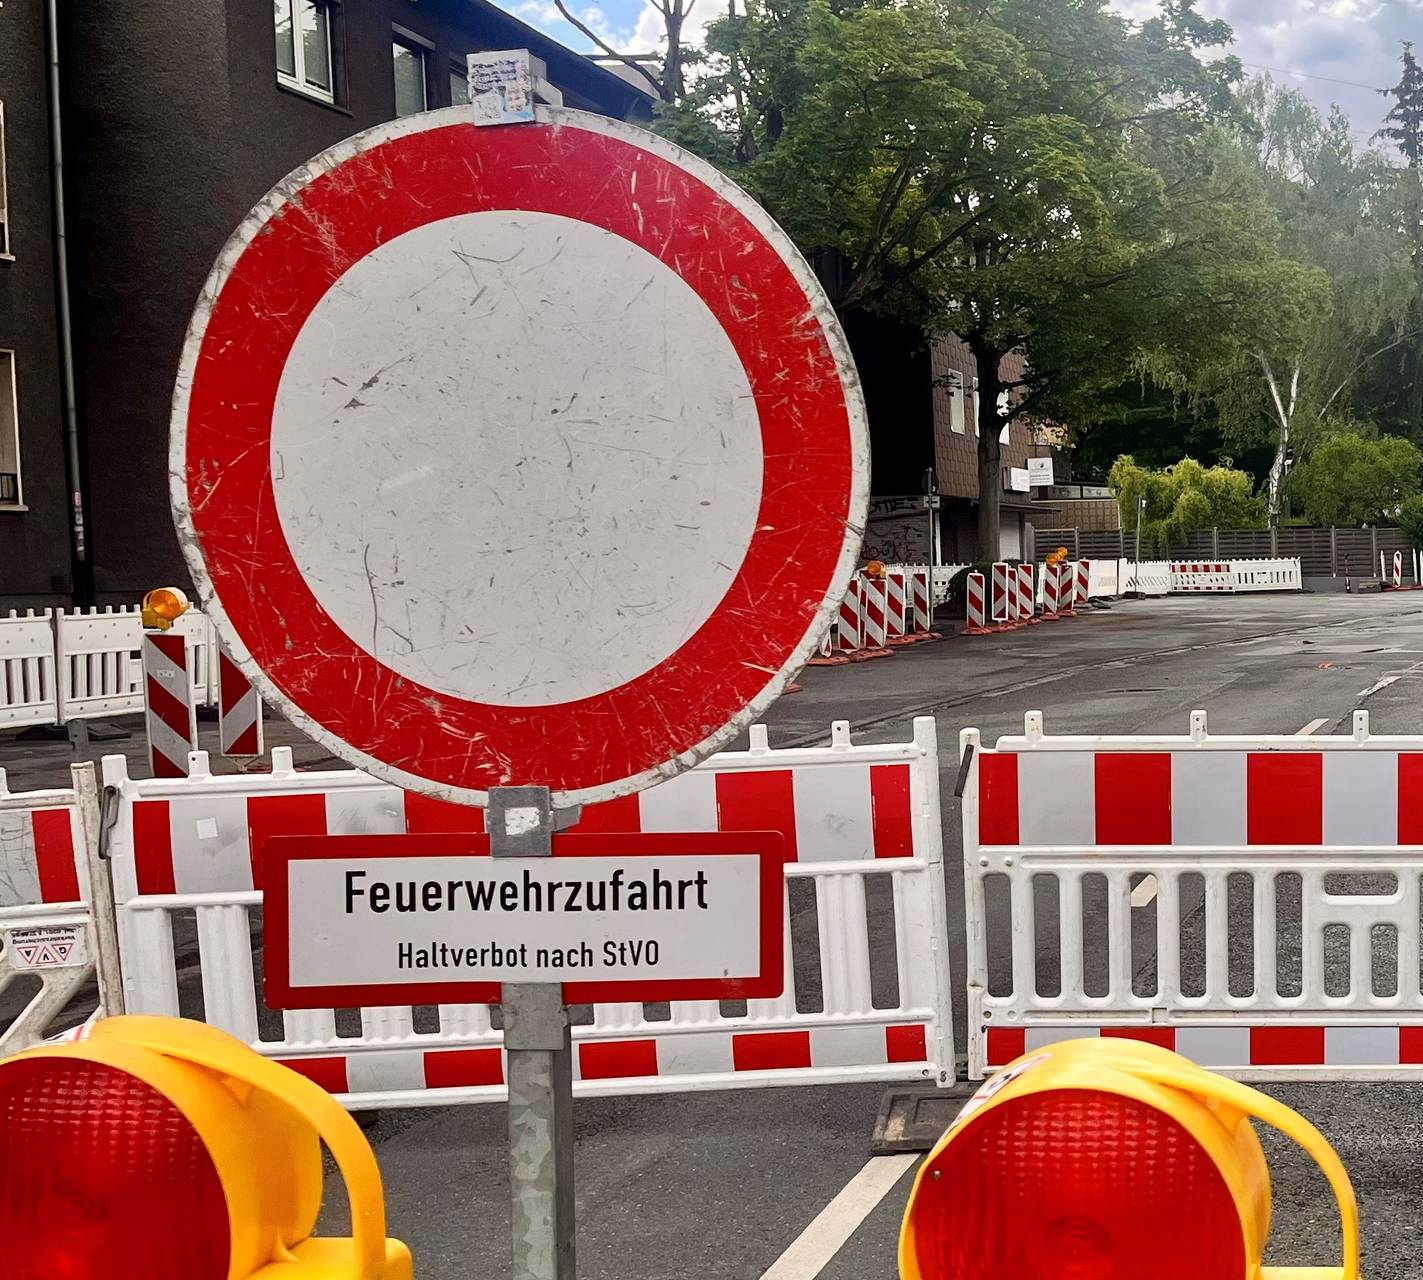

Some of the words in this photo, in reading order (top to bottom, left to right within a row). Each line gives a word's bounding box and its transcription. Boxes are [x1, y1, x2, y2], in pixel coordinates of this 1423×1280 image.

[345, 868, 708, 914] Feuerwehrzufahrt
[398, 941, 528, 969] Haltverbot
[536, 941, 594, 968] nach
[602, 939, 660, 967] StVO
